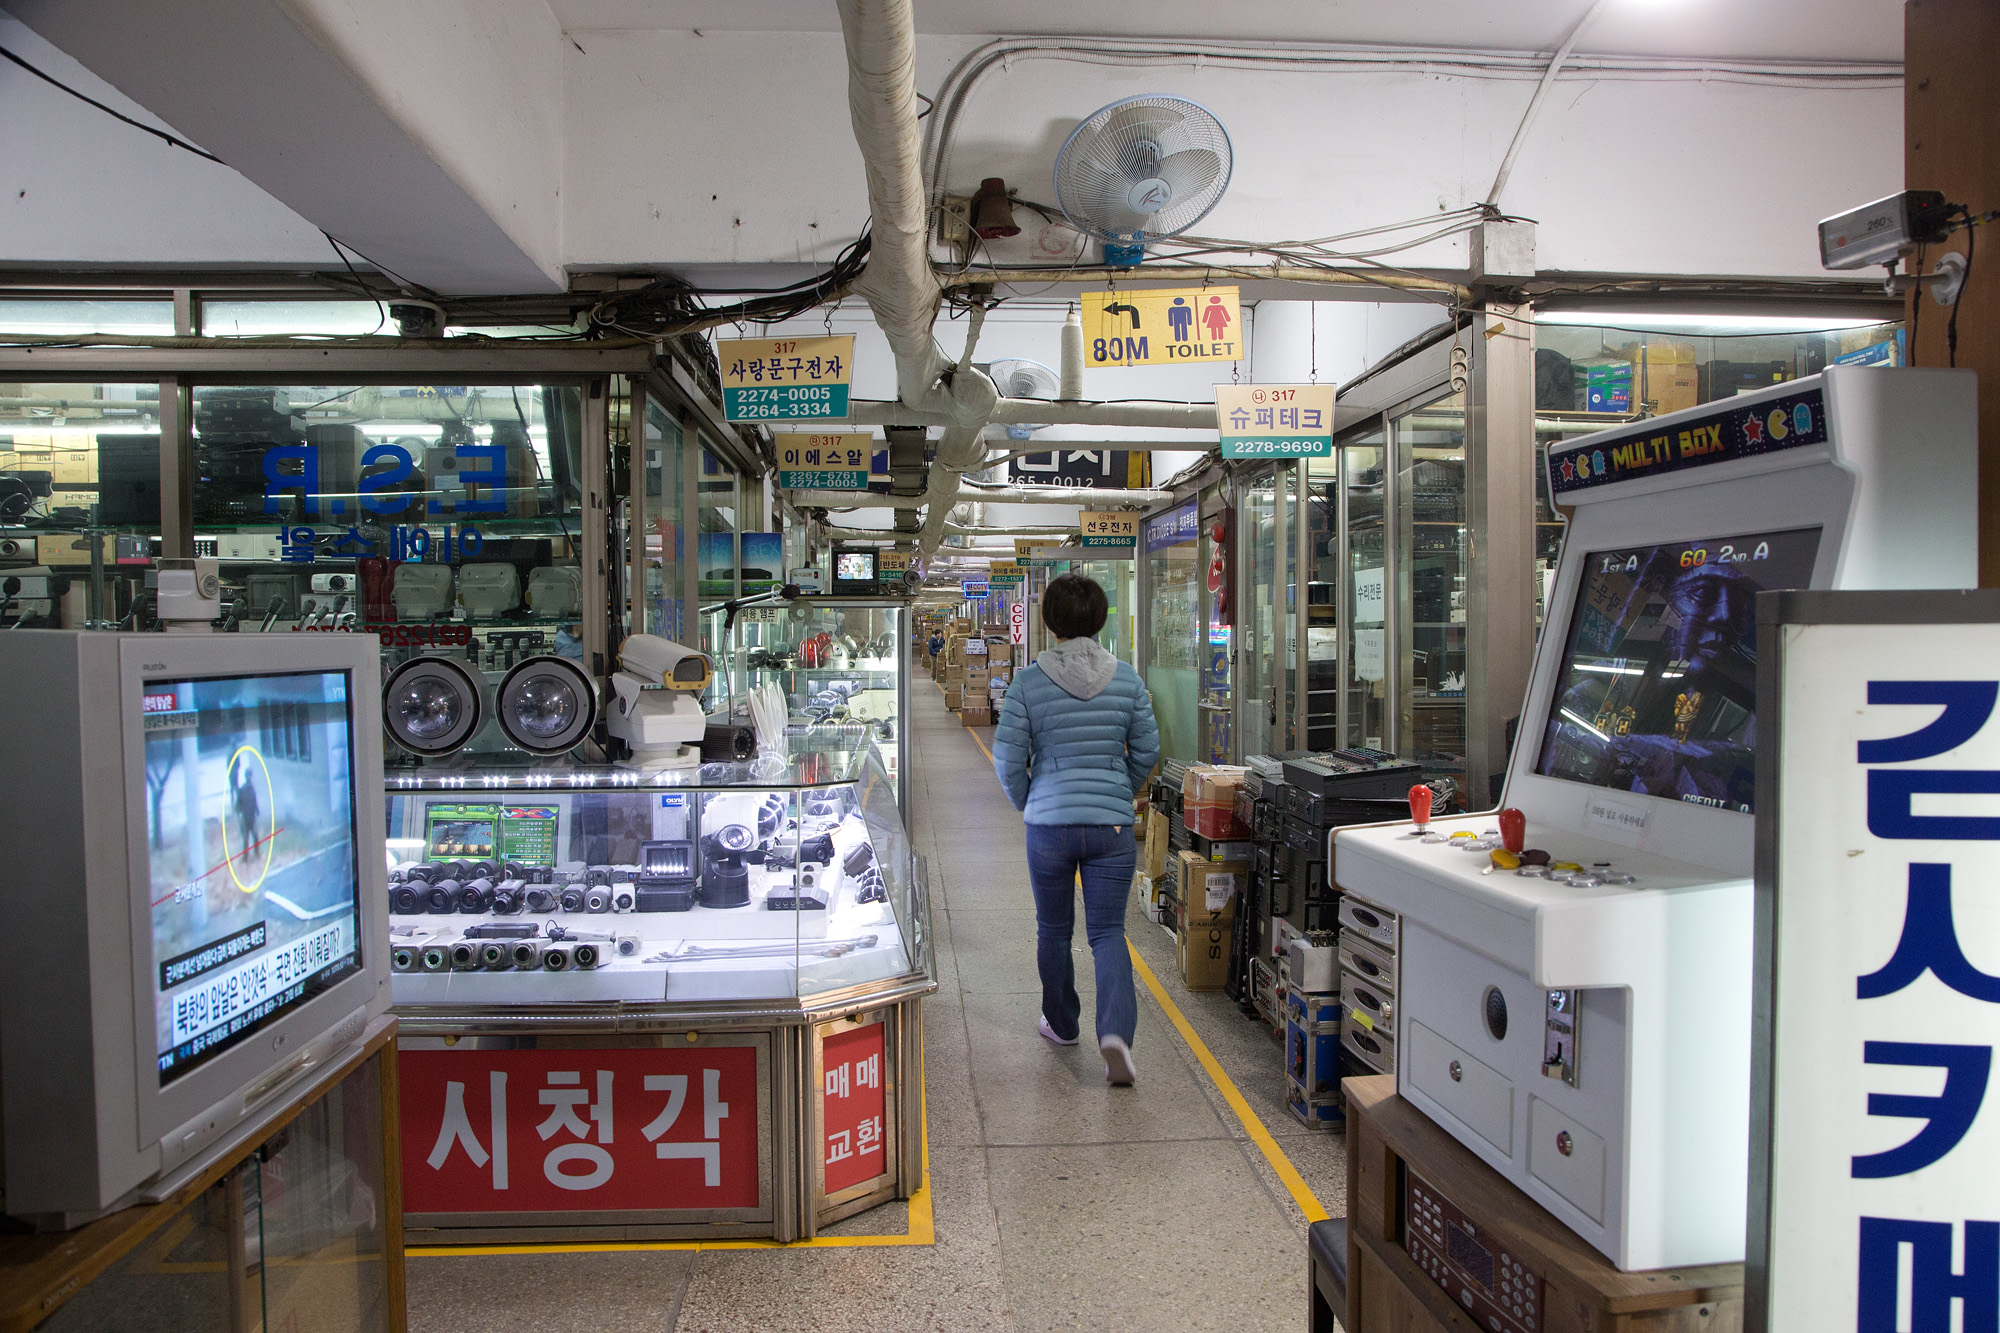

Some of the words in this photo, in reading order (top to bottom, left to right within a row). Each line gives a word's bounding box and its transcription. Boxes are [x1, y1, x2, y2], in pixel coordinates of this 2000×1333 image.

[774, 342, 797, 354] 317
[1093, 336, 1149, 362] 80M
[1165, 342, 1235, 358] TOILET
[729, 355, 843, 382] 사랑문구전자
[737, 387, 831, 403] 2274-0005
[1271, 389, 1296, 401] 317
[737, 403, 831, 418] 2264-3334
[1229, 407, 1322, 430] 슈퍼테크
[822, 436, 842, 446] 317
[1235, 441, 1322, 453] 2278-9690
[1612, 435, 1672, 472] MULTI
[1679, 423, 1725, 459] BOX
[785, 449, 863, 466] 이에스알
[790, 471, 858, 480] 2267-6761
[790, 479, 858, 488] 2274-0005
[1087, 521, 1133, 533] 선우전자
[1089, 537, 1131, 545] 2275-8665
[1679, 548, 1708, 568] 60
[1358, 583, 1382, 602] 수리전문
[1012, 604, 1023, 643] CCTV
[177, 988, 209, 1036] 북한의
[211, 975, 238, 1021] 앞날은
[293, 945, 308, 978] 전환
[309, 926, 341, 968] 이뤄질까?
[825, 1053, 879, 1100] 매매
[426, 1069, 730, 1191] 시청각
[825, 1115, 882, 1165] 교환
